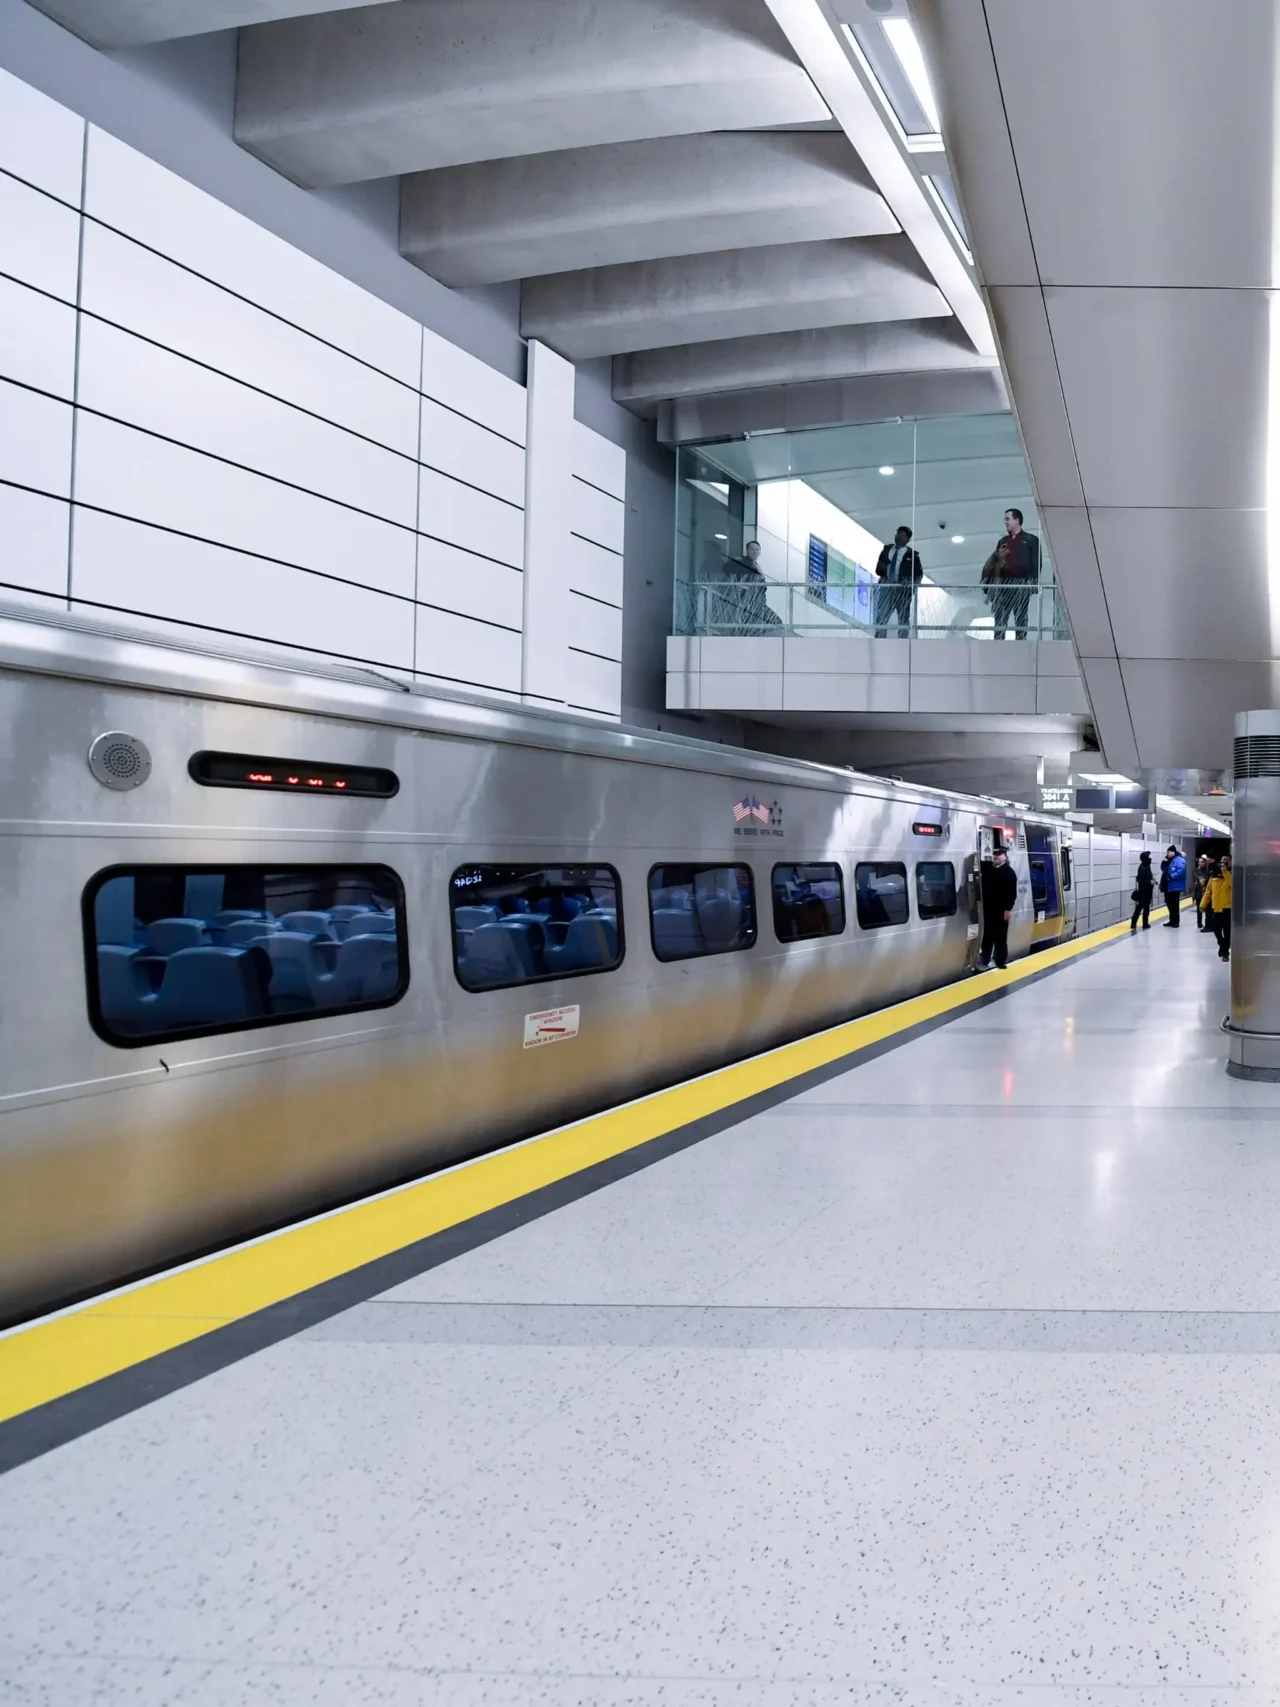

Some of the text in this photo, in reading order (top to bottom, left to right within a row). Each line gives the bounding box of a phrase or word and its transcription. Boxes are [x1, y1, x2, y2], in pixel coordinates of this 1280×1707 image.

[1042, 793, 1069, 801] 304 A
[743, 827, 758, 836] SERVE
[530, 1010, 557, 1021] EMERGENCY
